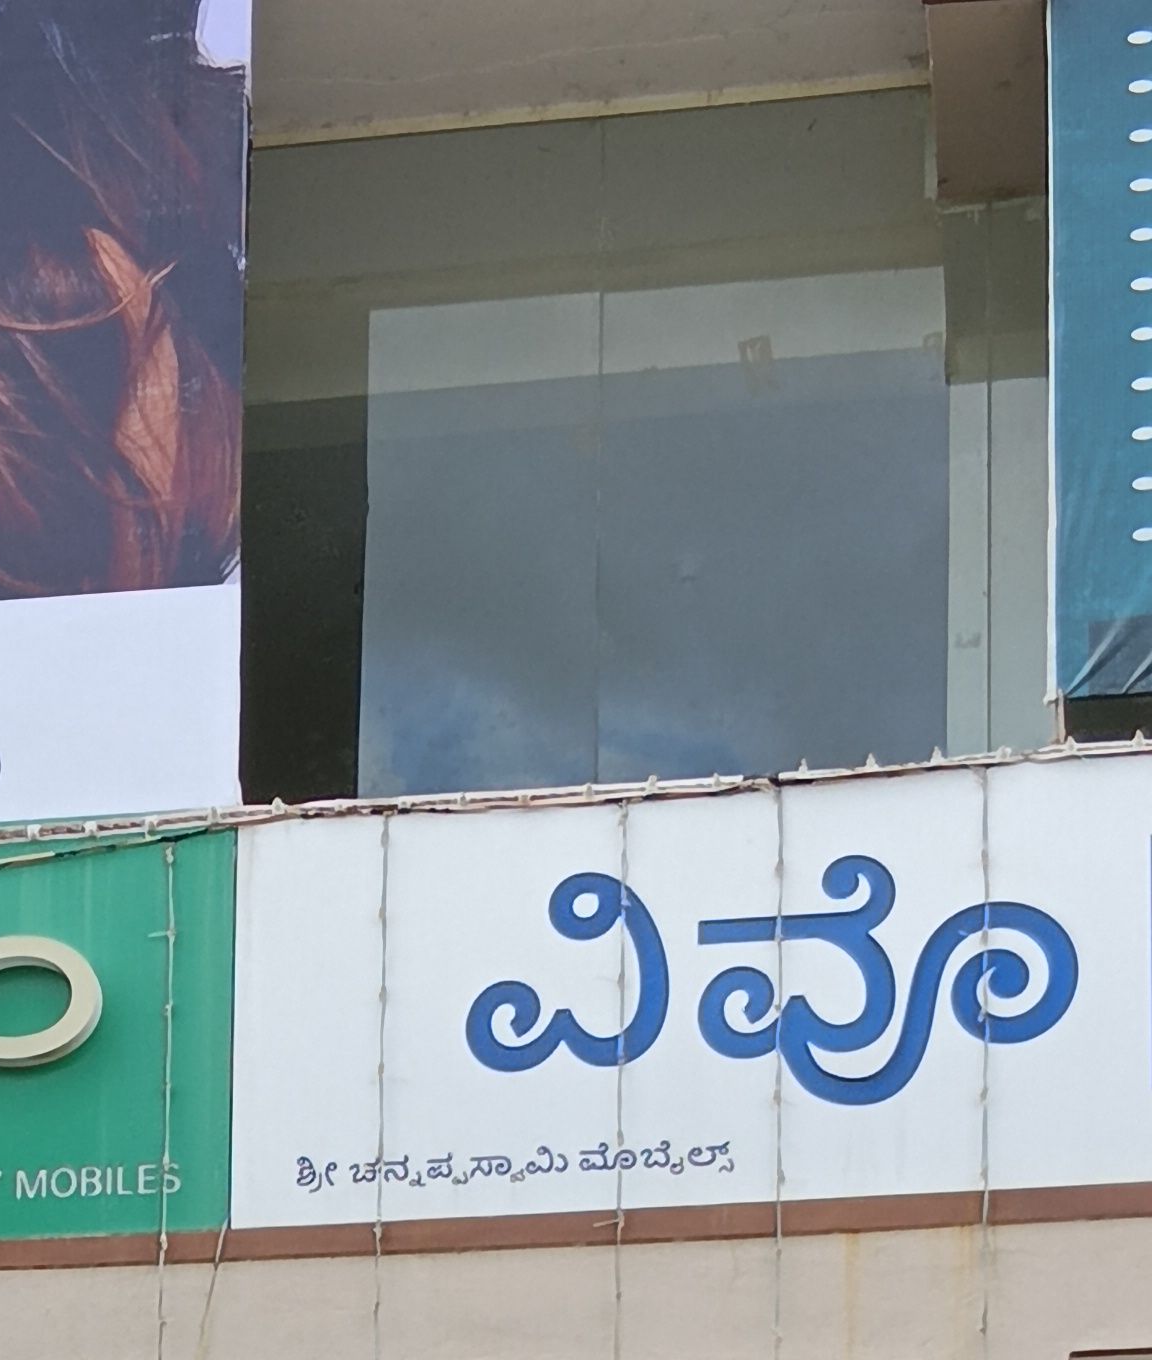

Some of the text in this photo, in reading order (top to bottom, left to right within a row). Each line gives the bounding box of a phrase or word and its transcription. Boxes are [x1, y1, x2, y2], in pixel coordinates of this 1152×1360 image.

[15, 1163, 182, 1199] MOBILES
[296, 1156, 338, 1193] ಶ್ರೀ
[579, 1140, 735, 1173] ಮೊಬೈಲ್ಸ್
